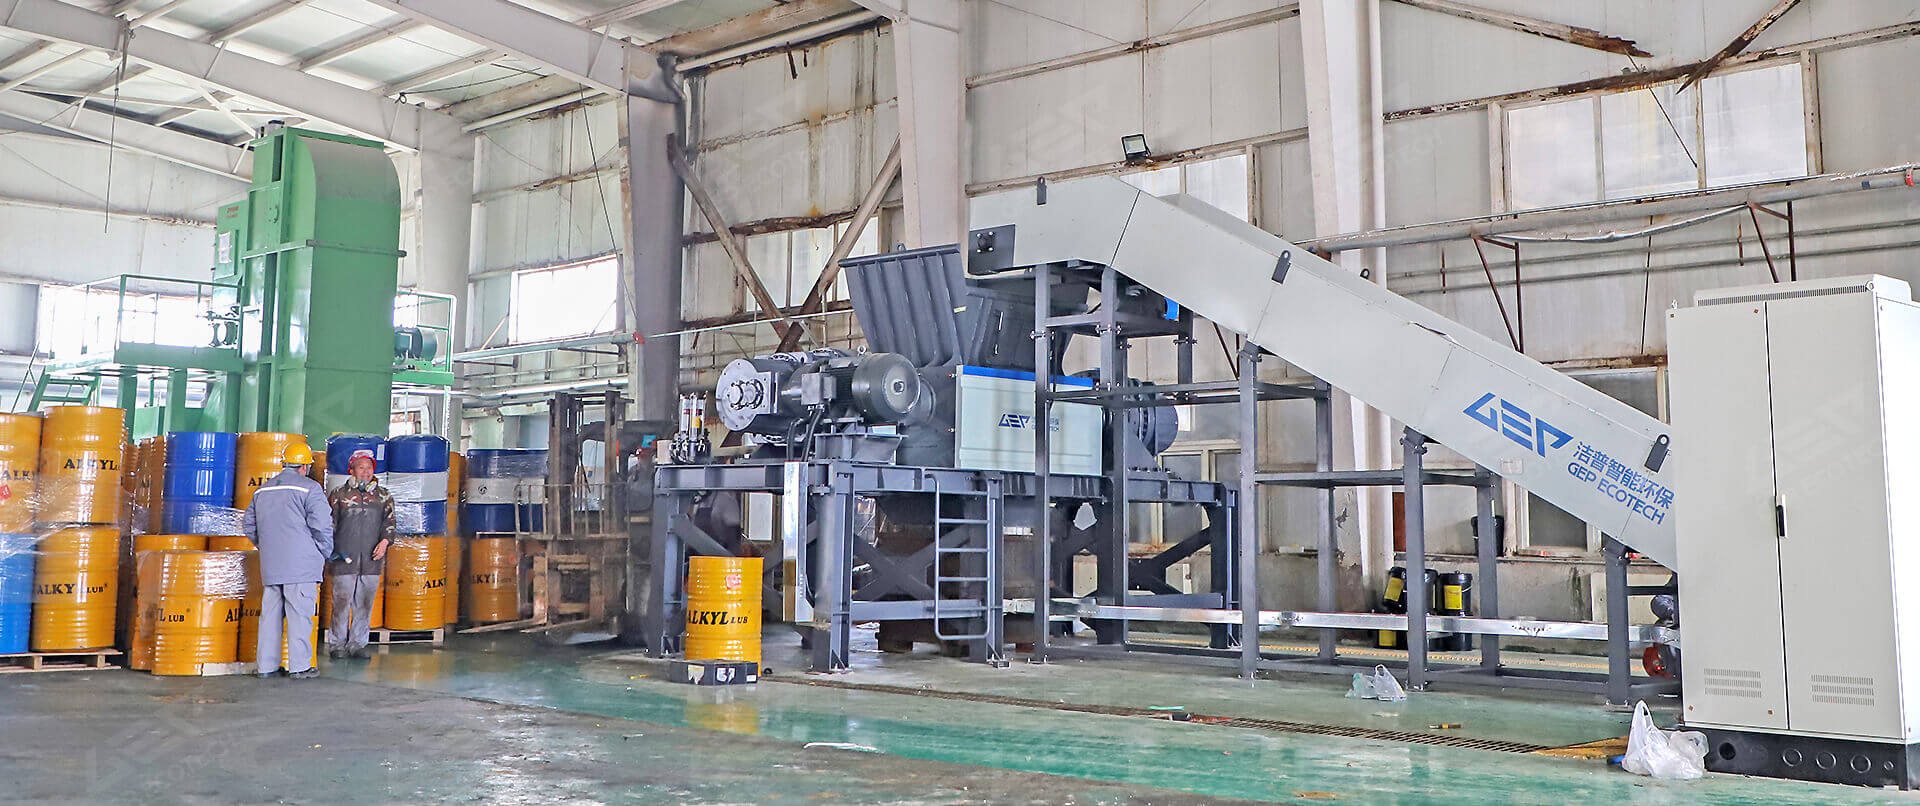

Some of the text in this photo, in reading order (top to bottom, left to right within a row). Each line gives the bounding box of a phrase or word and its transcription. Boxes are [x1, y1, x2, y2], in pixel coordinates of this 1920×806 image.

[998, 413, 1031, 429] GEP
[1463, 392, 1574, 458] GEP
[1567, 462, 1665, 525] GEP ECOTECH
[1571, 441, 1675, 510] 洁普智能环保
[168, 614, 185, 622] LUB
[730, 616, 748, 624] LUB
